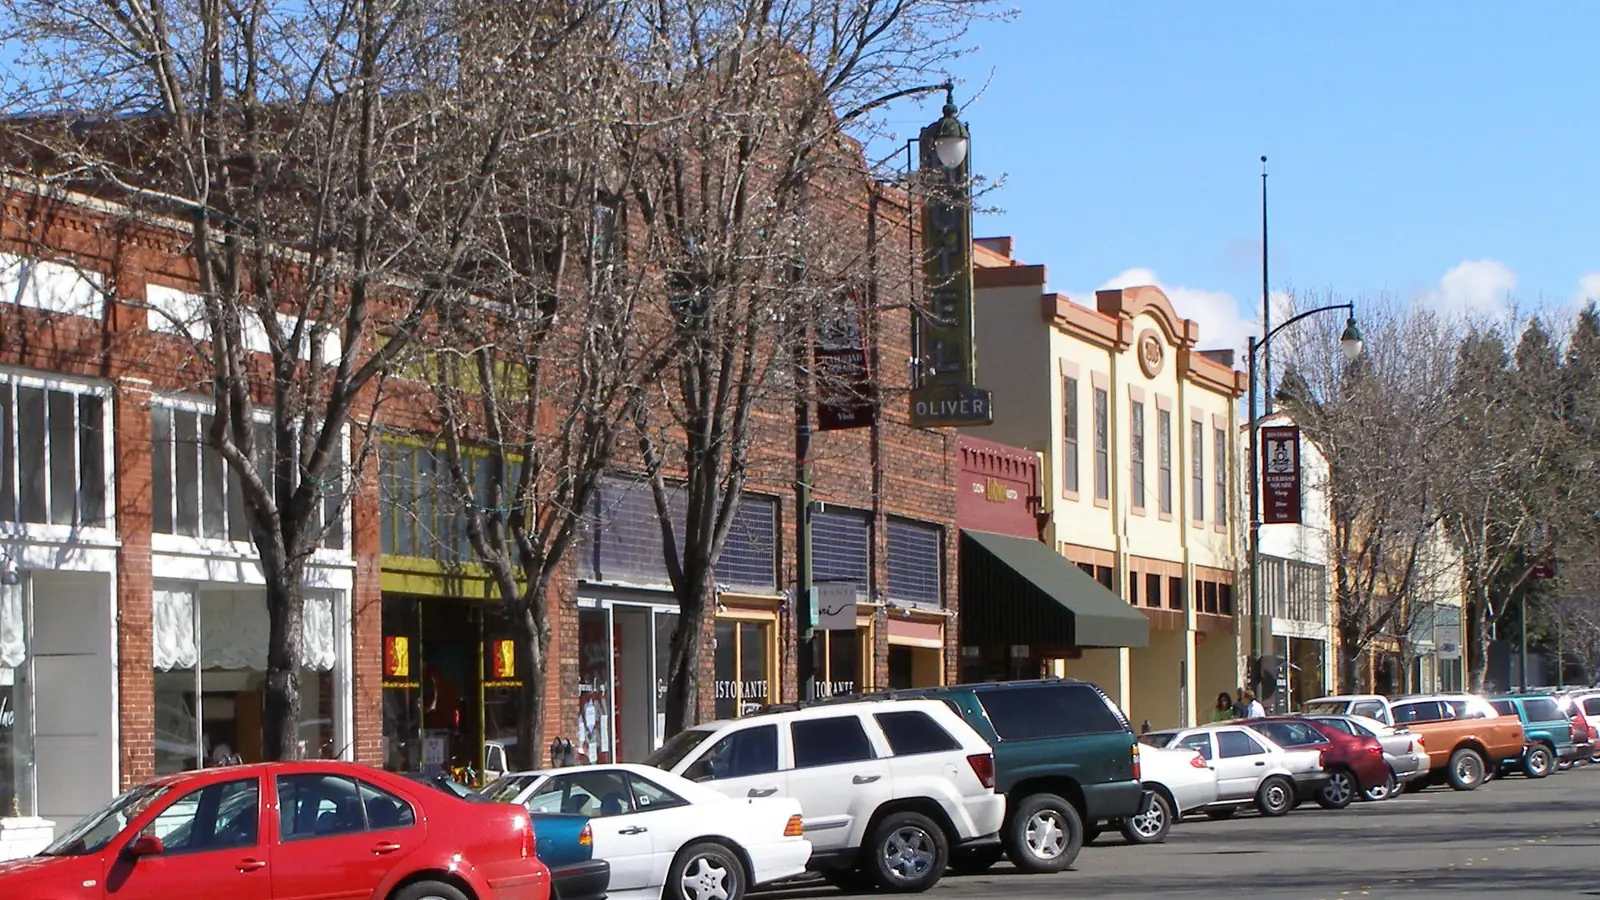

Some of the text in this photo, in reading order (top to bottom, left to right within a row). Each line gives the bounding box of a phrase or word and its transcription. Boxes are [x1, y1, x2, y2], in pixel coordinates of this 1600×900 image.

[931, 158, 961, 373] OTEL
[916, 399, 984, 416] OLIVER
[715, 680, 768, 699] ISTORANTE
[815, 681, 854, 698] TORANTE
